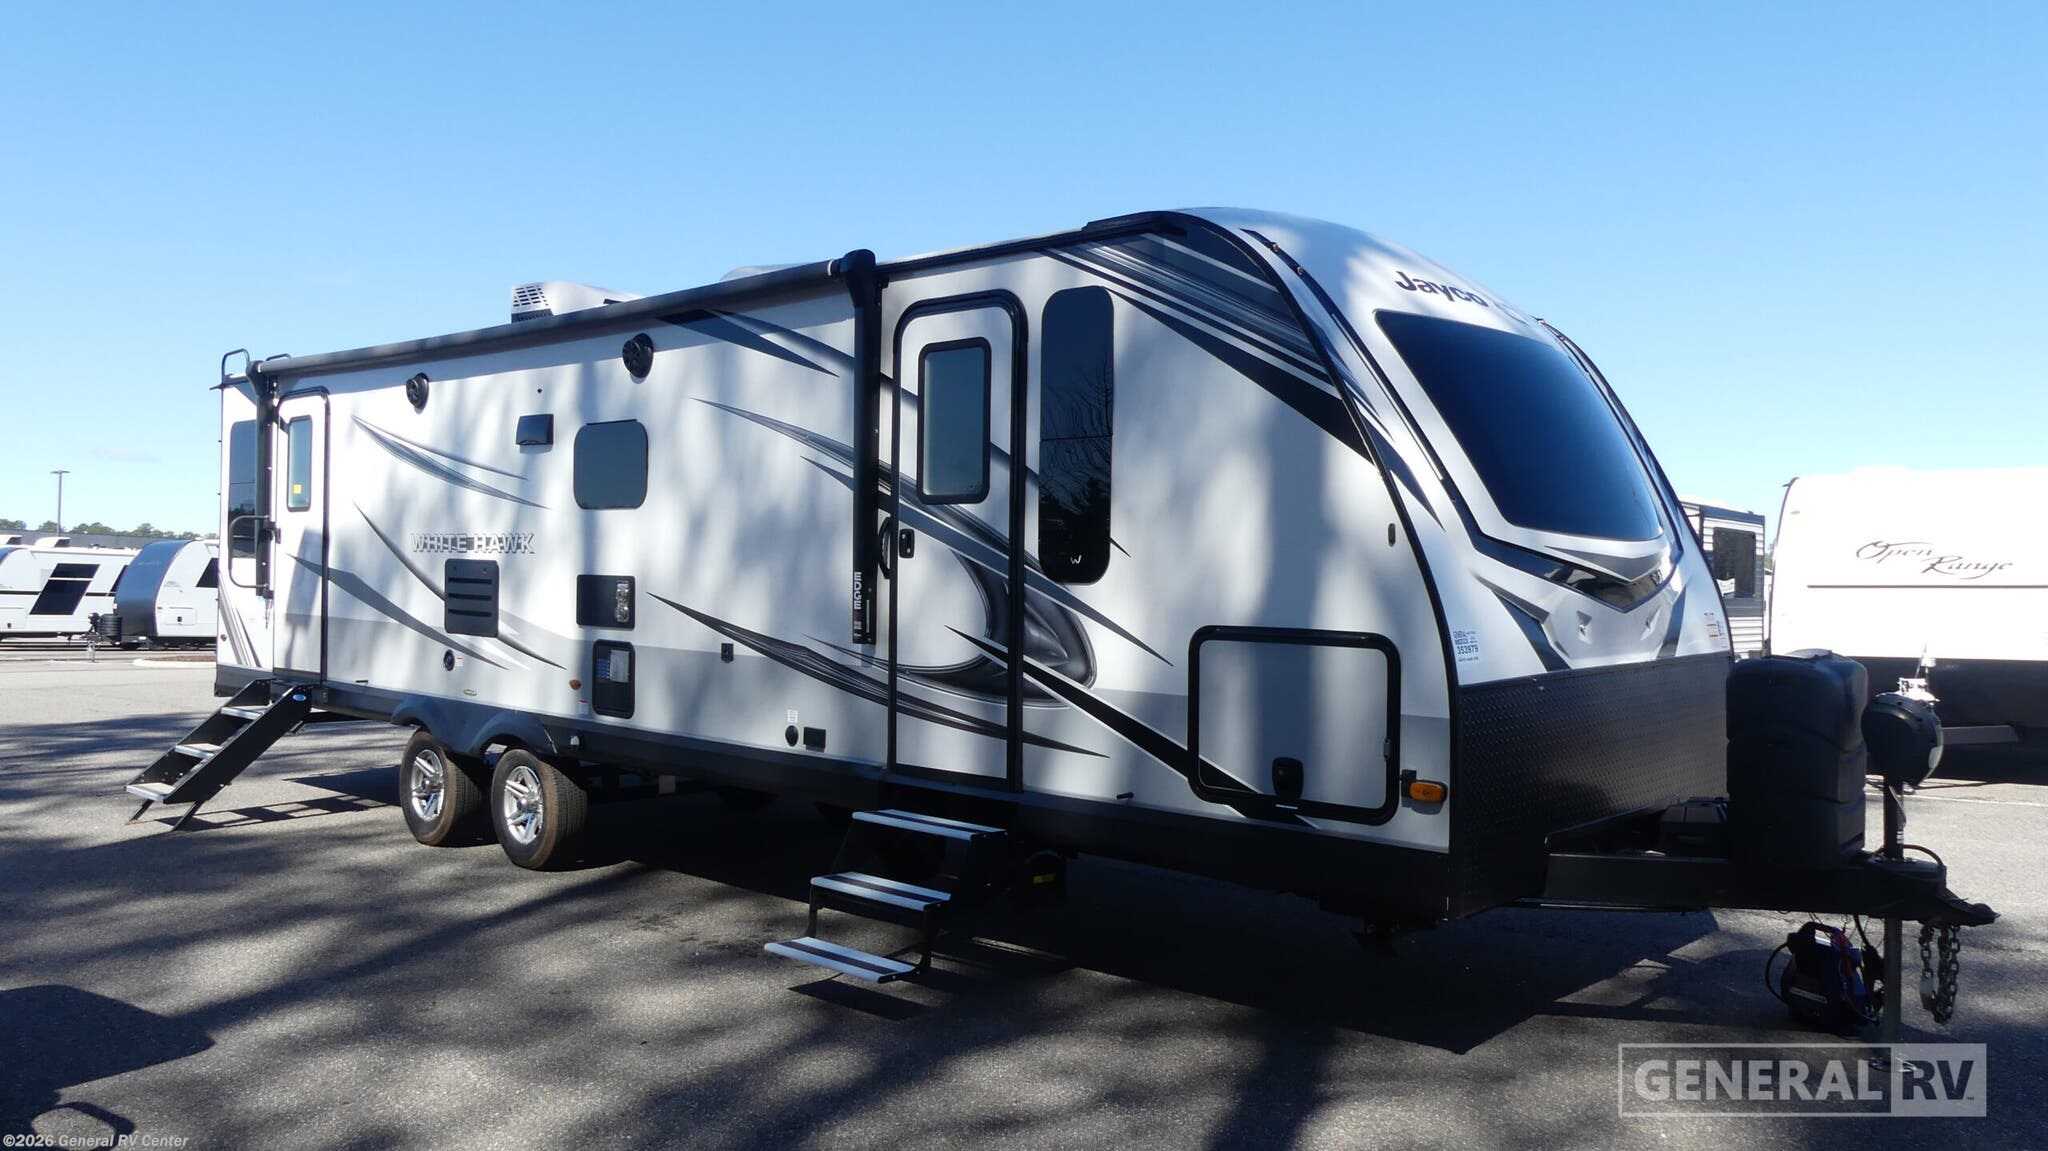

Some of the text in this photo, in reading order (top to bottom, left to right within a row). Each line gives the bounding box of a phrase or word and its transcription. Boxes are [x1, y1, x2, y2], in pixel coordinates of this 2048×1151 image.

[1394, 270, 1489, 307] Jayco
[411, 532, 535, 554] WHITE HAWK
[1856, 540, 1934, 564] Open
[1920, 555, 2013, 580] Range
[853, 571, 862, 610] EDGE
